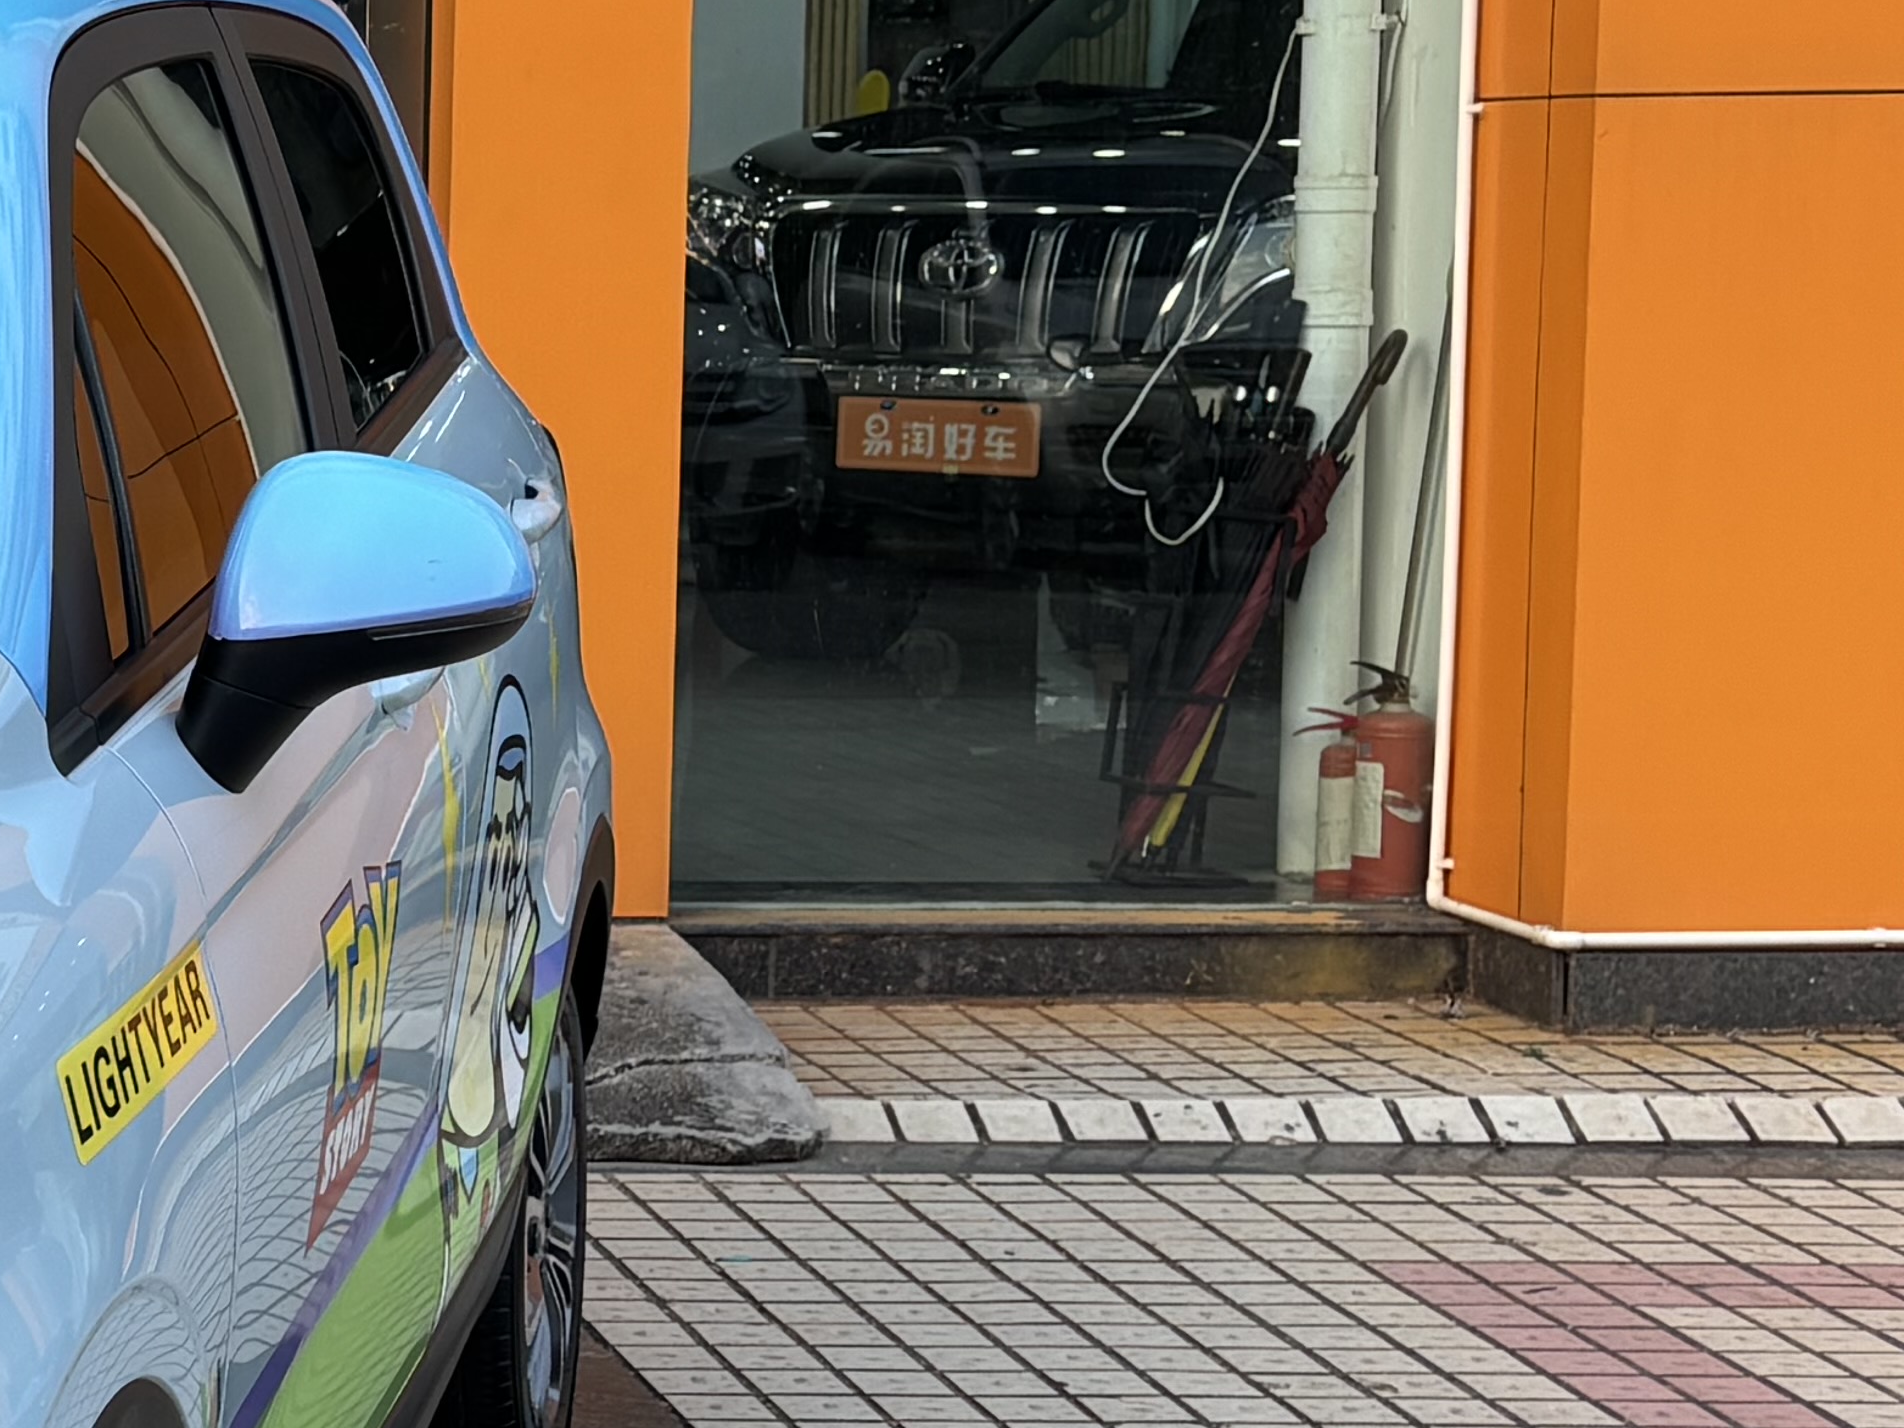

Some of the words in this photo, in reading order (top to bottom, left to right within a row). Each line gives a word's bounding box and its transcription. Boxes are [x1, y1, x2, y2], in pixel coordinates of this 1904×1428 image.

[862, 412, 1018, 461] 易淘好车
[64, 958, 212, 1146] LIGHTYEAR
[319, 860, 402, 1117] TOY
